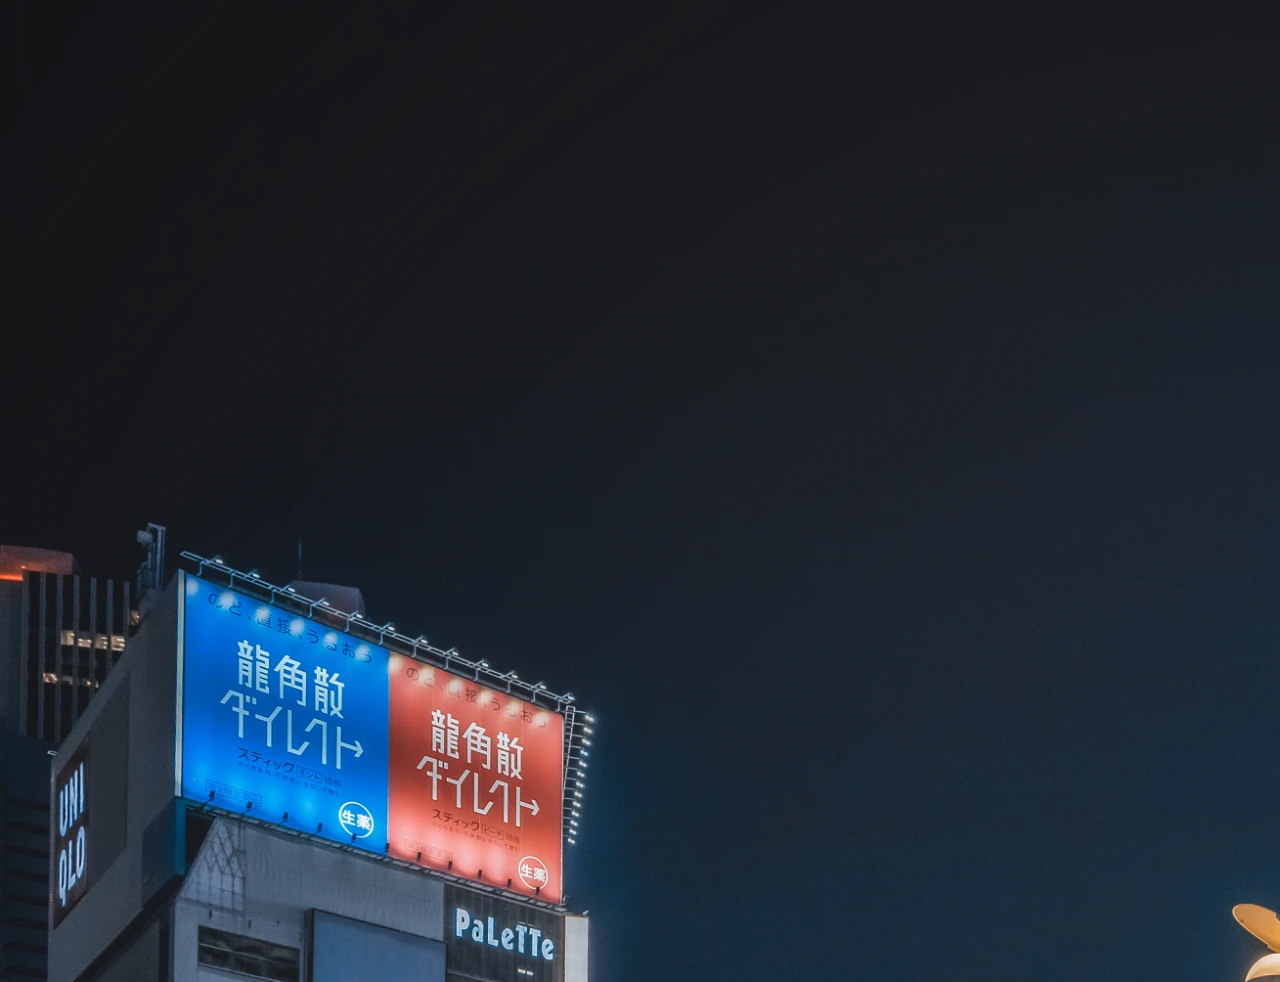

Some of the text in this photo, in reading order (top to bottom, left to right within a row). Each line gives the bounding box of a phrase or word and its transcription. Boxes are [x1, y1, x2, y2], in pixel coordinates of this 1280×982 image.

[236, 639, 346, 719] 龍角散
[219, 688, 364, 771] ダイレクト
[237, 747, 295, 774] スティック
[430, 708, 524, 780] 龍角散
[58, 761, 85, 837] UNI
[341, 809, 372, 831] 生薬
[415, 755, 540, 827] ダイレクト
[432, 808, 480, 831] スティック
[58, 826, 86, 908] QLO
[520, 863, 547, 883] 生薬
